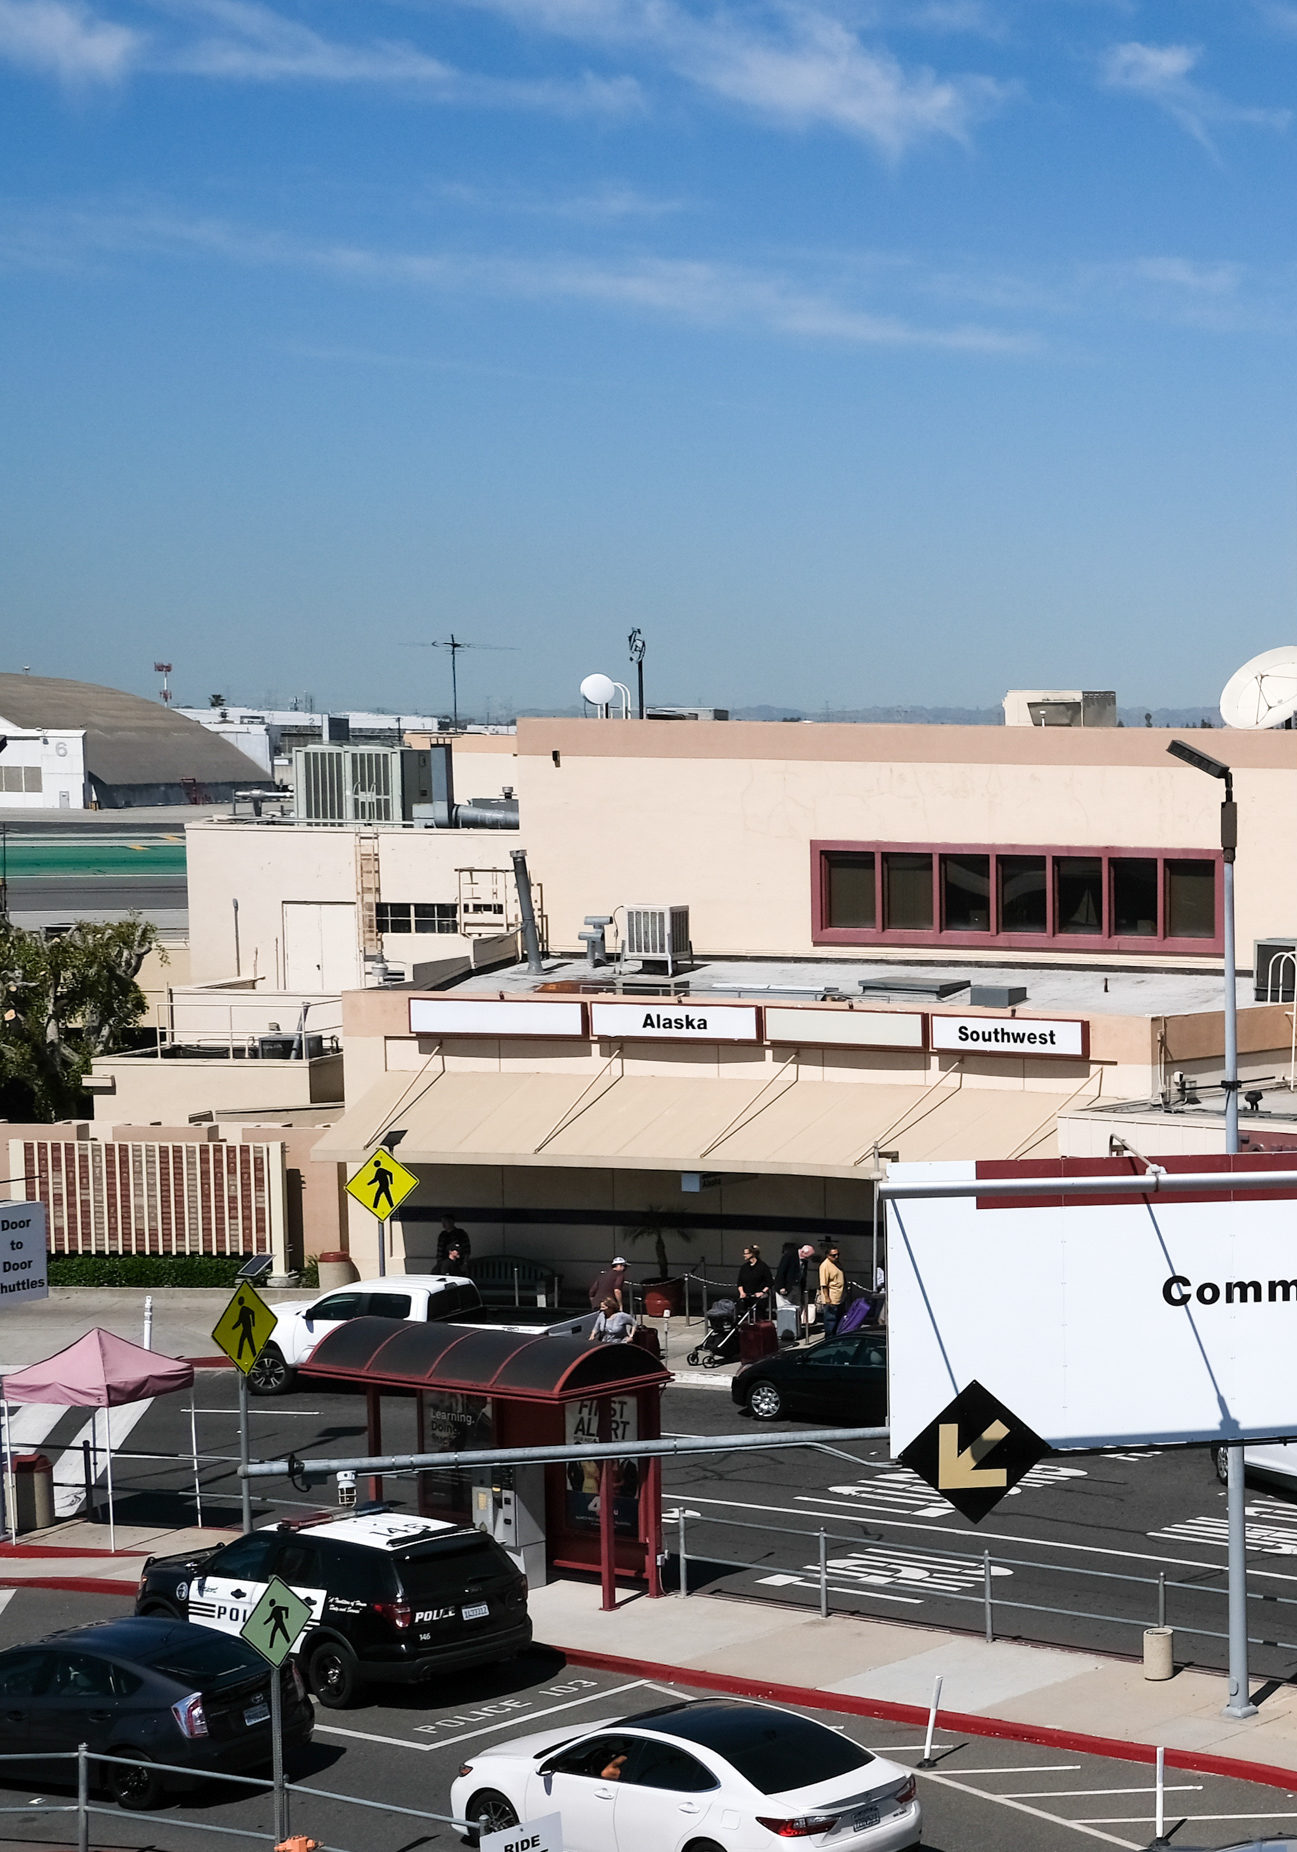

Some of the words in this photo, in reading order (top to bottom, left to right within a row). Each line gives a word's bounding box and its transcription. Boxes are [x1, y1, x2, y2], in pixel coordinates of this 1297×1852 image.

[55, 742, 69, 758] 6
[641, 1013, 708, 1032] Alaska
[957, 1025, 1056, 1047] Southwest
[1, 1218, 31, 1232] Door
[10, 1240, 24, 1251] to
[3, 1259, 33, 1273] Door
[0, 1278, 45, 1294] huttles
[578, 1398, 627, 1420] FIST
[574, 1415, 631, 1440] ALRT
[413, 1698, 533, 1735] POLICE
[538, 1678, 599, 1698] 103
[503, 1834, 541, 1852] RIDE
